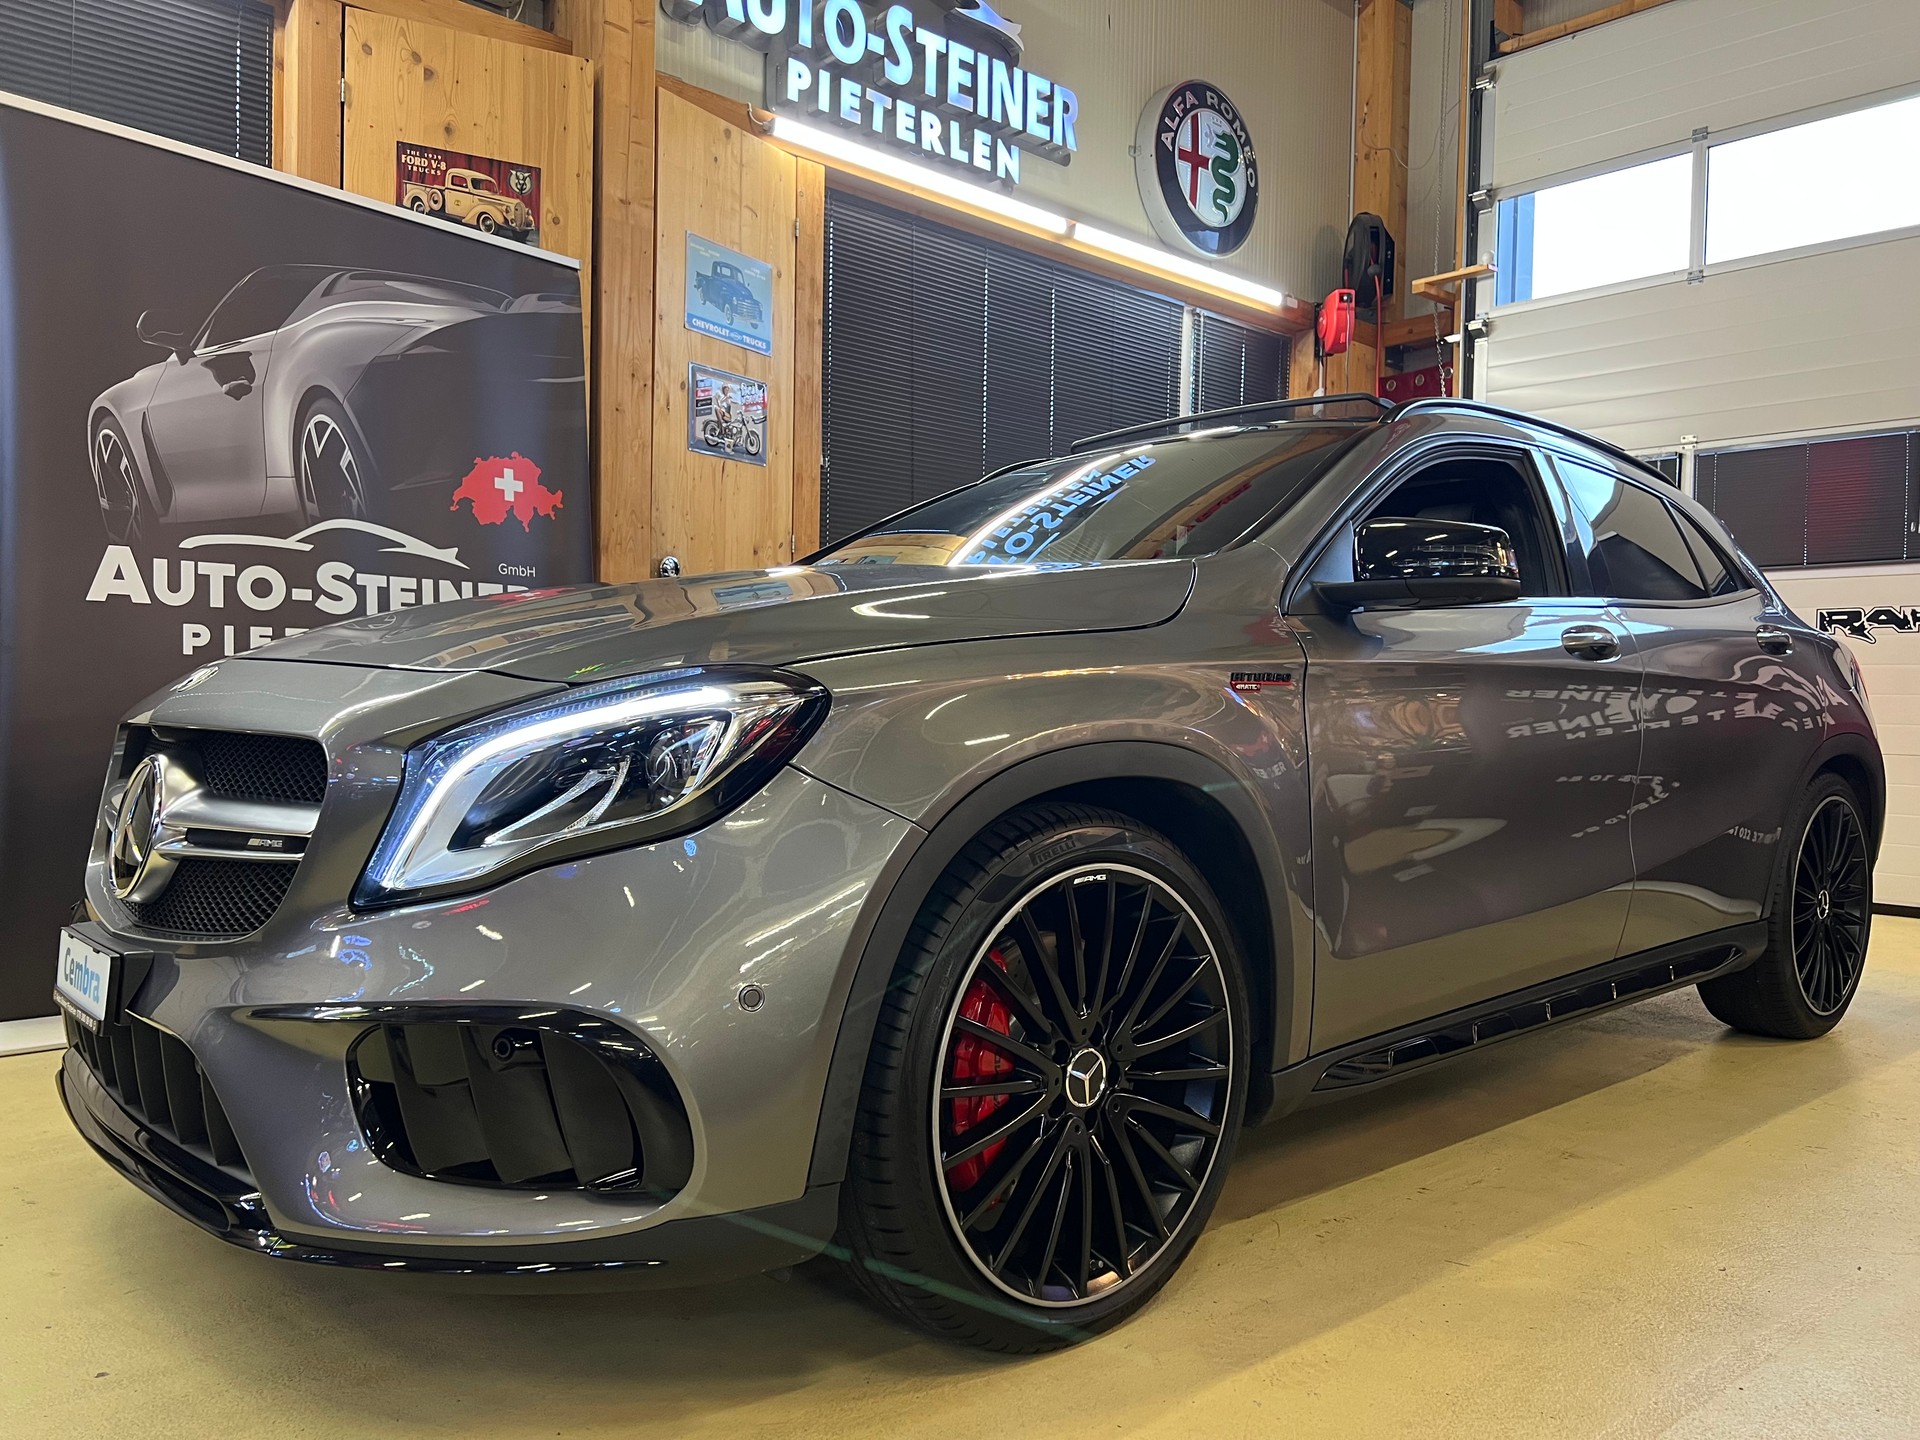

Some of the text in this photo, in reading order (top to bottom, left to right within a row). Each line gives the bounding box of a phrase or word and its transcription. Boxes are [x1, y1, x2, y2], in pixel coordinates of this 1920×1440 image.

[787, 57, 1020, 185] PIETERLEN
[1161, 91, 1256, 188] ALFA ROMEO
[401, 154, 447, 171] FORD V-8
[424, 152, 442, 160] 1939
[407, 164, 442, 176] TRUCKS
[692, 317, 730, 337] CHEVROLET
[742, 335, 767, 350] TRUCKS
[498, 563, 536, 577] GmbH
[258, 839, 283, 848] AMG
[1029, 837, 1077, 867] PIRELLI
[1083, 874, 1107, 883] AMG
[64, 947, 102, 1005] Cembra
